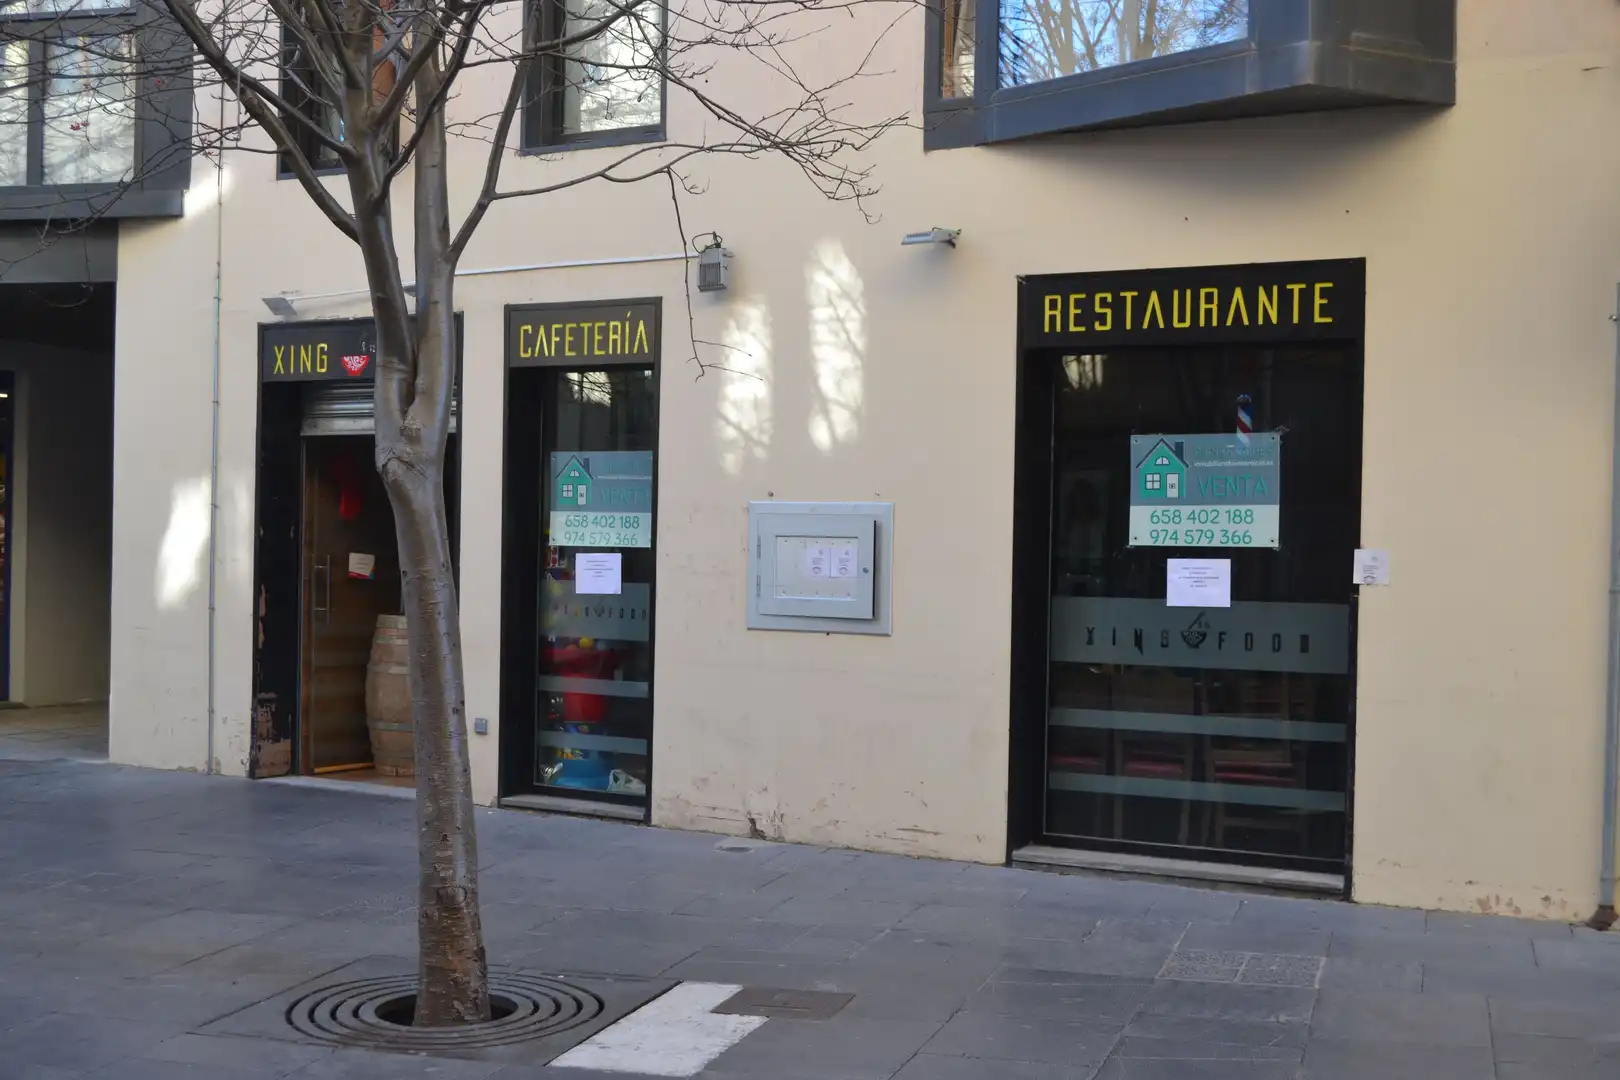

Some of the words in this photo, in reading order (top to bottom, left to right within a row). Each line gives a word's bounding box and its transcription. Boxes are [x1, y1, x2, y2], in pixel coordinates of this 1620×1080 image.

[1043, 282, 1334, 334] RESTAURANTE
[519, 310, 649, 358] CAFETERÍA
[273, 342, 328, 375] XING
[1197, 474, 1268, 498] VENTA
[564, 514, 588, 528] 658
[591, 515, 616, 529] 402
[619, 515, 640, 529] 188
[1150, 509, 1182, 525] 658
[1186, 509, 1220, 525] 402
[1224, 509, 1254, 525] 188
[564, 531, 585, 545] 974
[588, 532, 611, 545] 579
[614, 532, 638, 546] 366
[1150, 529, 1179, 544] 974
[1184, 529, 1215, 545] 579
[1219, 529, 1252, 545] 366
[1085, 626, 1170, 654] XING
